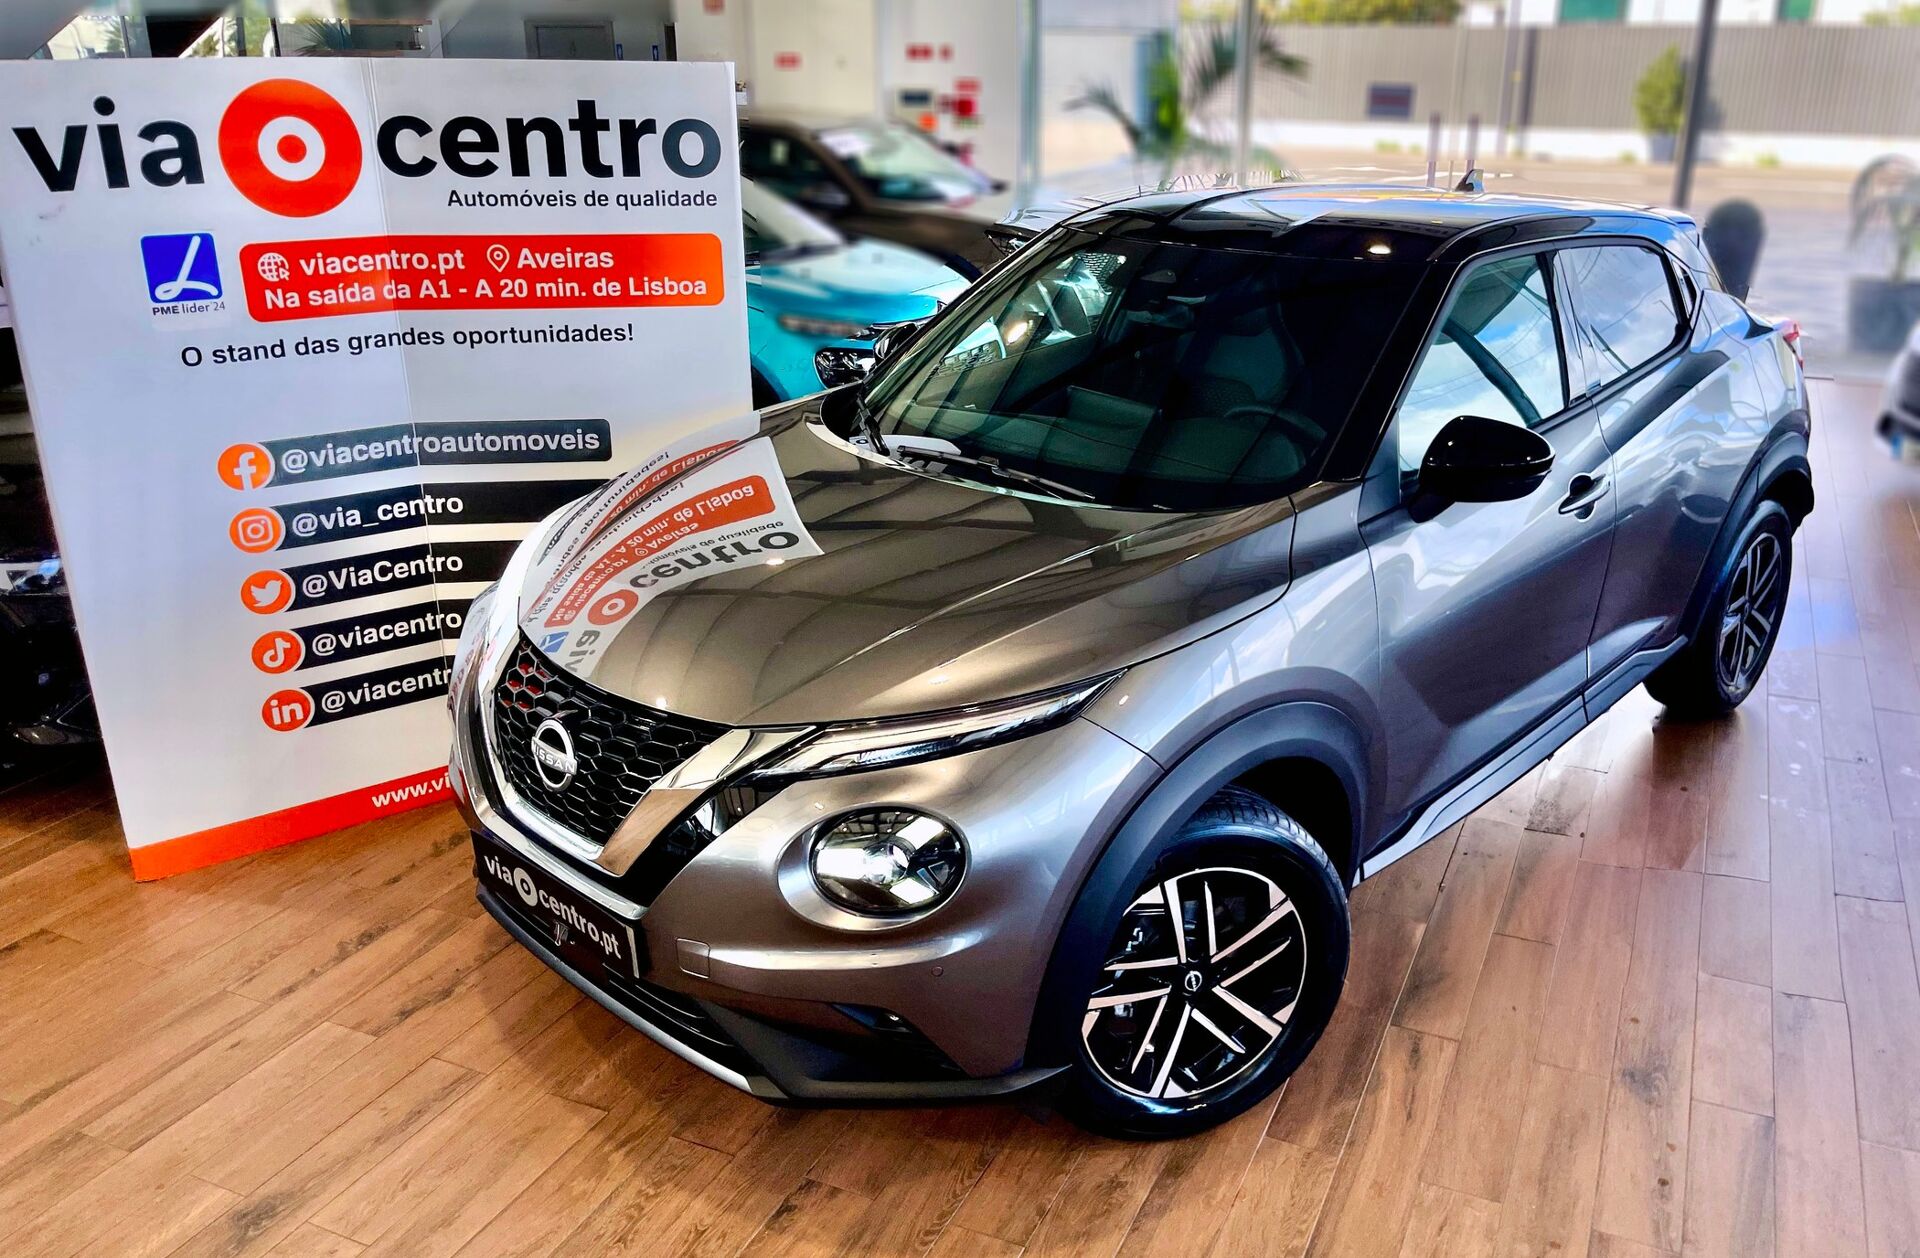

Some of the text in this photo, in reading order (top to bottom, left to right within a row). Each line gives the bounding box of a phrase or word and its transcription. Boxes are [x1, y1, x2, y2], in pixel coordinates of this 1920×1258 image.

[12, 96, 721, 193] via centro
[448, 190, 717, 211] Automóveis de qualidade
[300, 249, 465, 276] viacentro.pt
[517, 247, 614, 269] Aveiras
[152, 305, 180, 315] PME
[264, 289, 300, 310] Na
[309, 282, 375, 306] saída
[383, 280, 412, 300] da
[419, 279, 451, 298] A1
[475, 279, 494, 297] A
[500, 278, 528, 297] 20
[535, 277, 587, 297] min.
[592, 277, 622, 297] de
[628, 276, 707, 297] Lisboa
[181, 323, 634, 366] O stand das grandes oportunidades!
[281, 429, 600, 474] @viacentroautomoveis
[292, 495, 464, 537] @via_centro
[302, 554, 464, 599] @ViaCentro
[312, 612, 462, 657] @viacentro
[532, 740, 576, 773] NISSAN
[484, 854, 622, 959] via centro.pt
